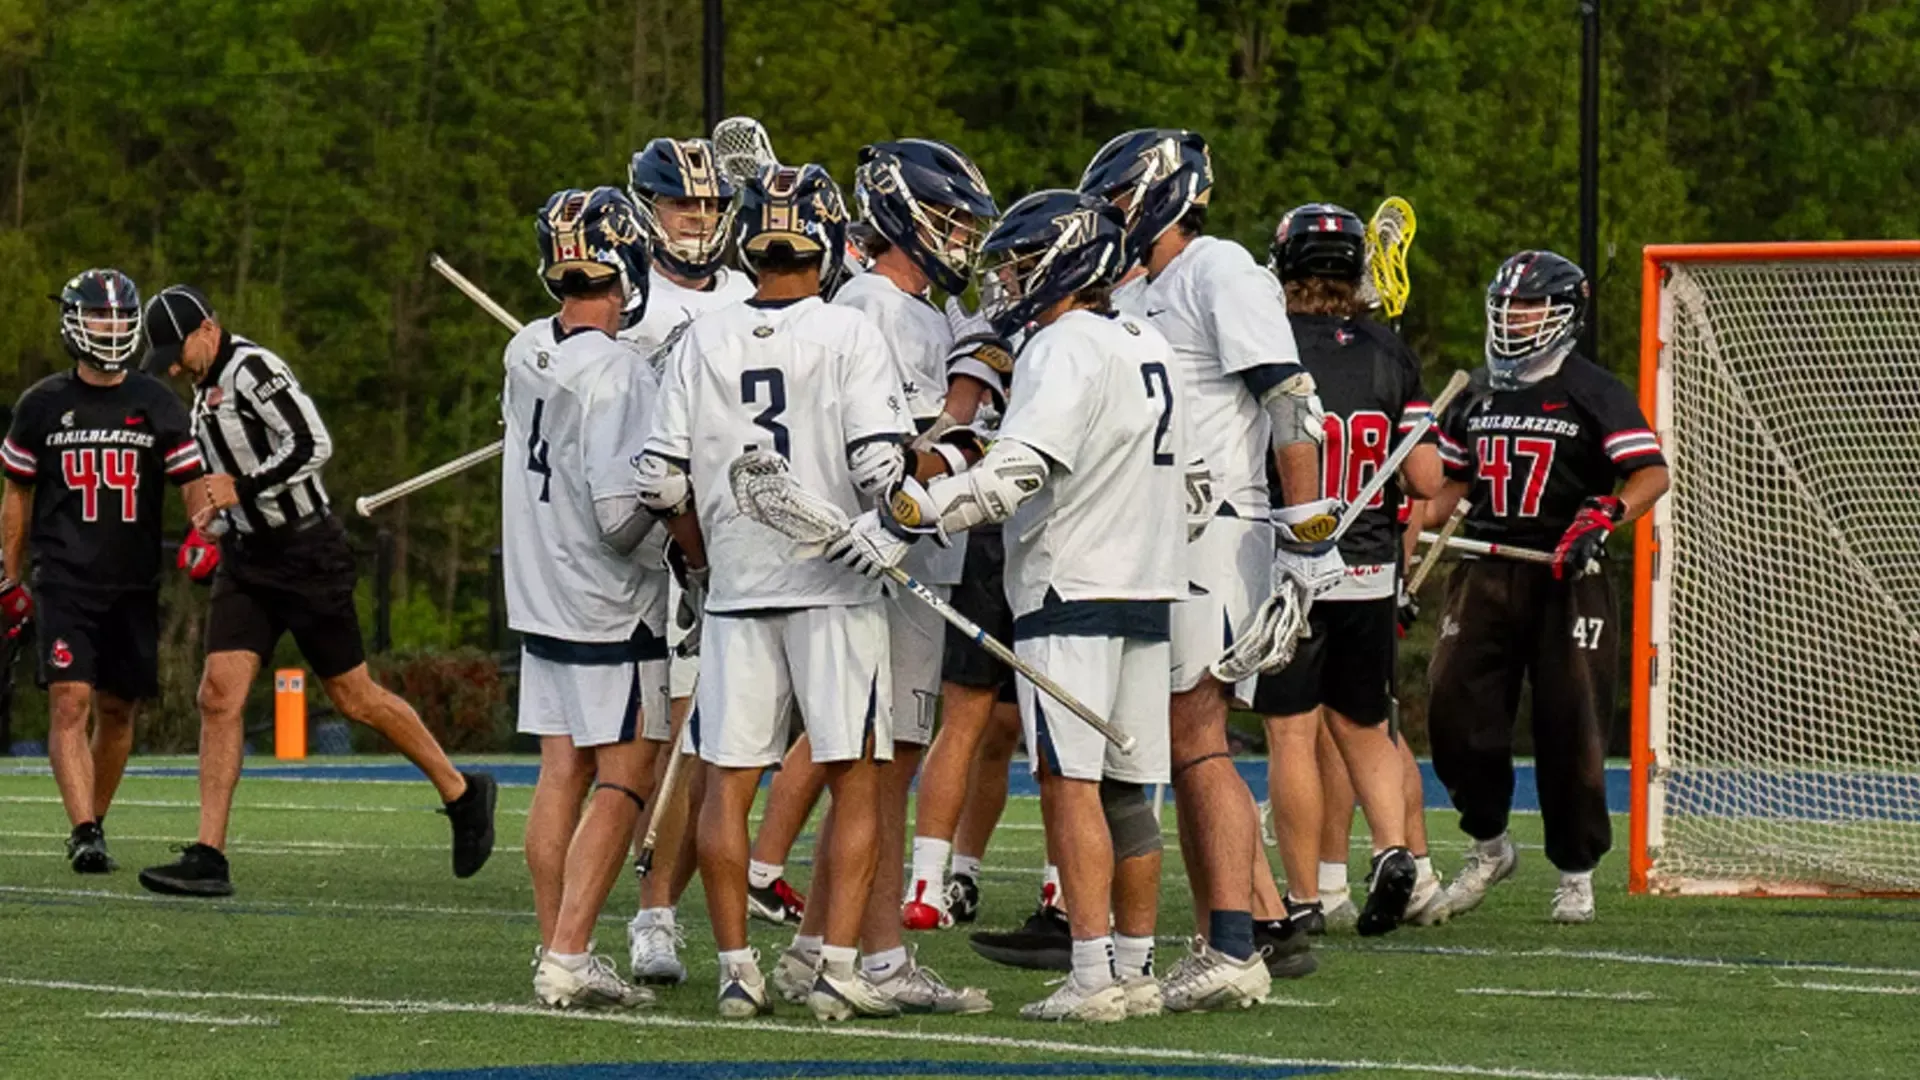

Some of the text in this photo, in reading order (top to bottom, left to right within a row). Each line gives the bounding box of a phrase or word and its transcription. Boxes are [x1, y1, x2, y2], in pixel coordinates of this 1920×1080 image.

[527, 398, 552, 503] 4
[741, 367, 791, 474] 3
[1140, 362, 1175, 466] 2
[1321, 411, 1391, 509] 18
[61, 447, 140, 522] 44
[1476, 434, 1556, 517] 47
[1572, 616, 1605, 650] 47
